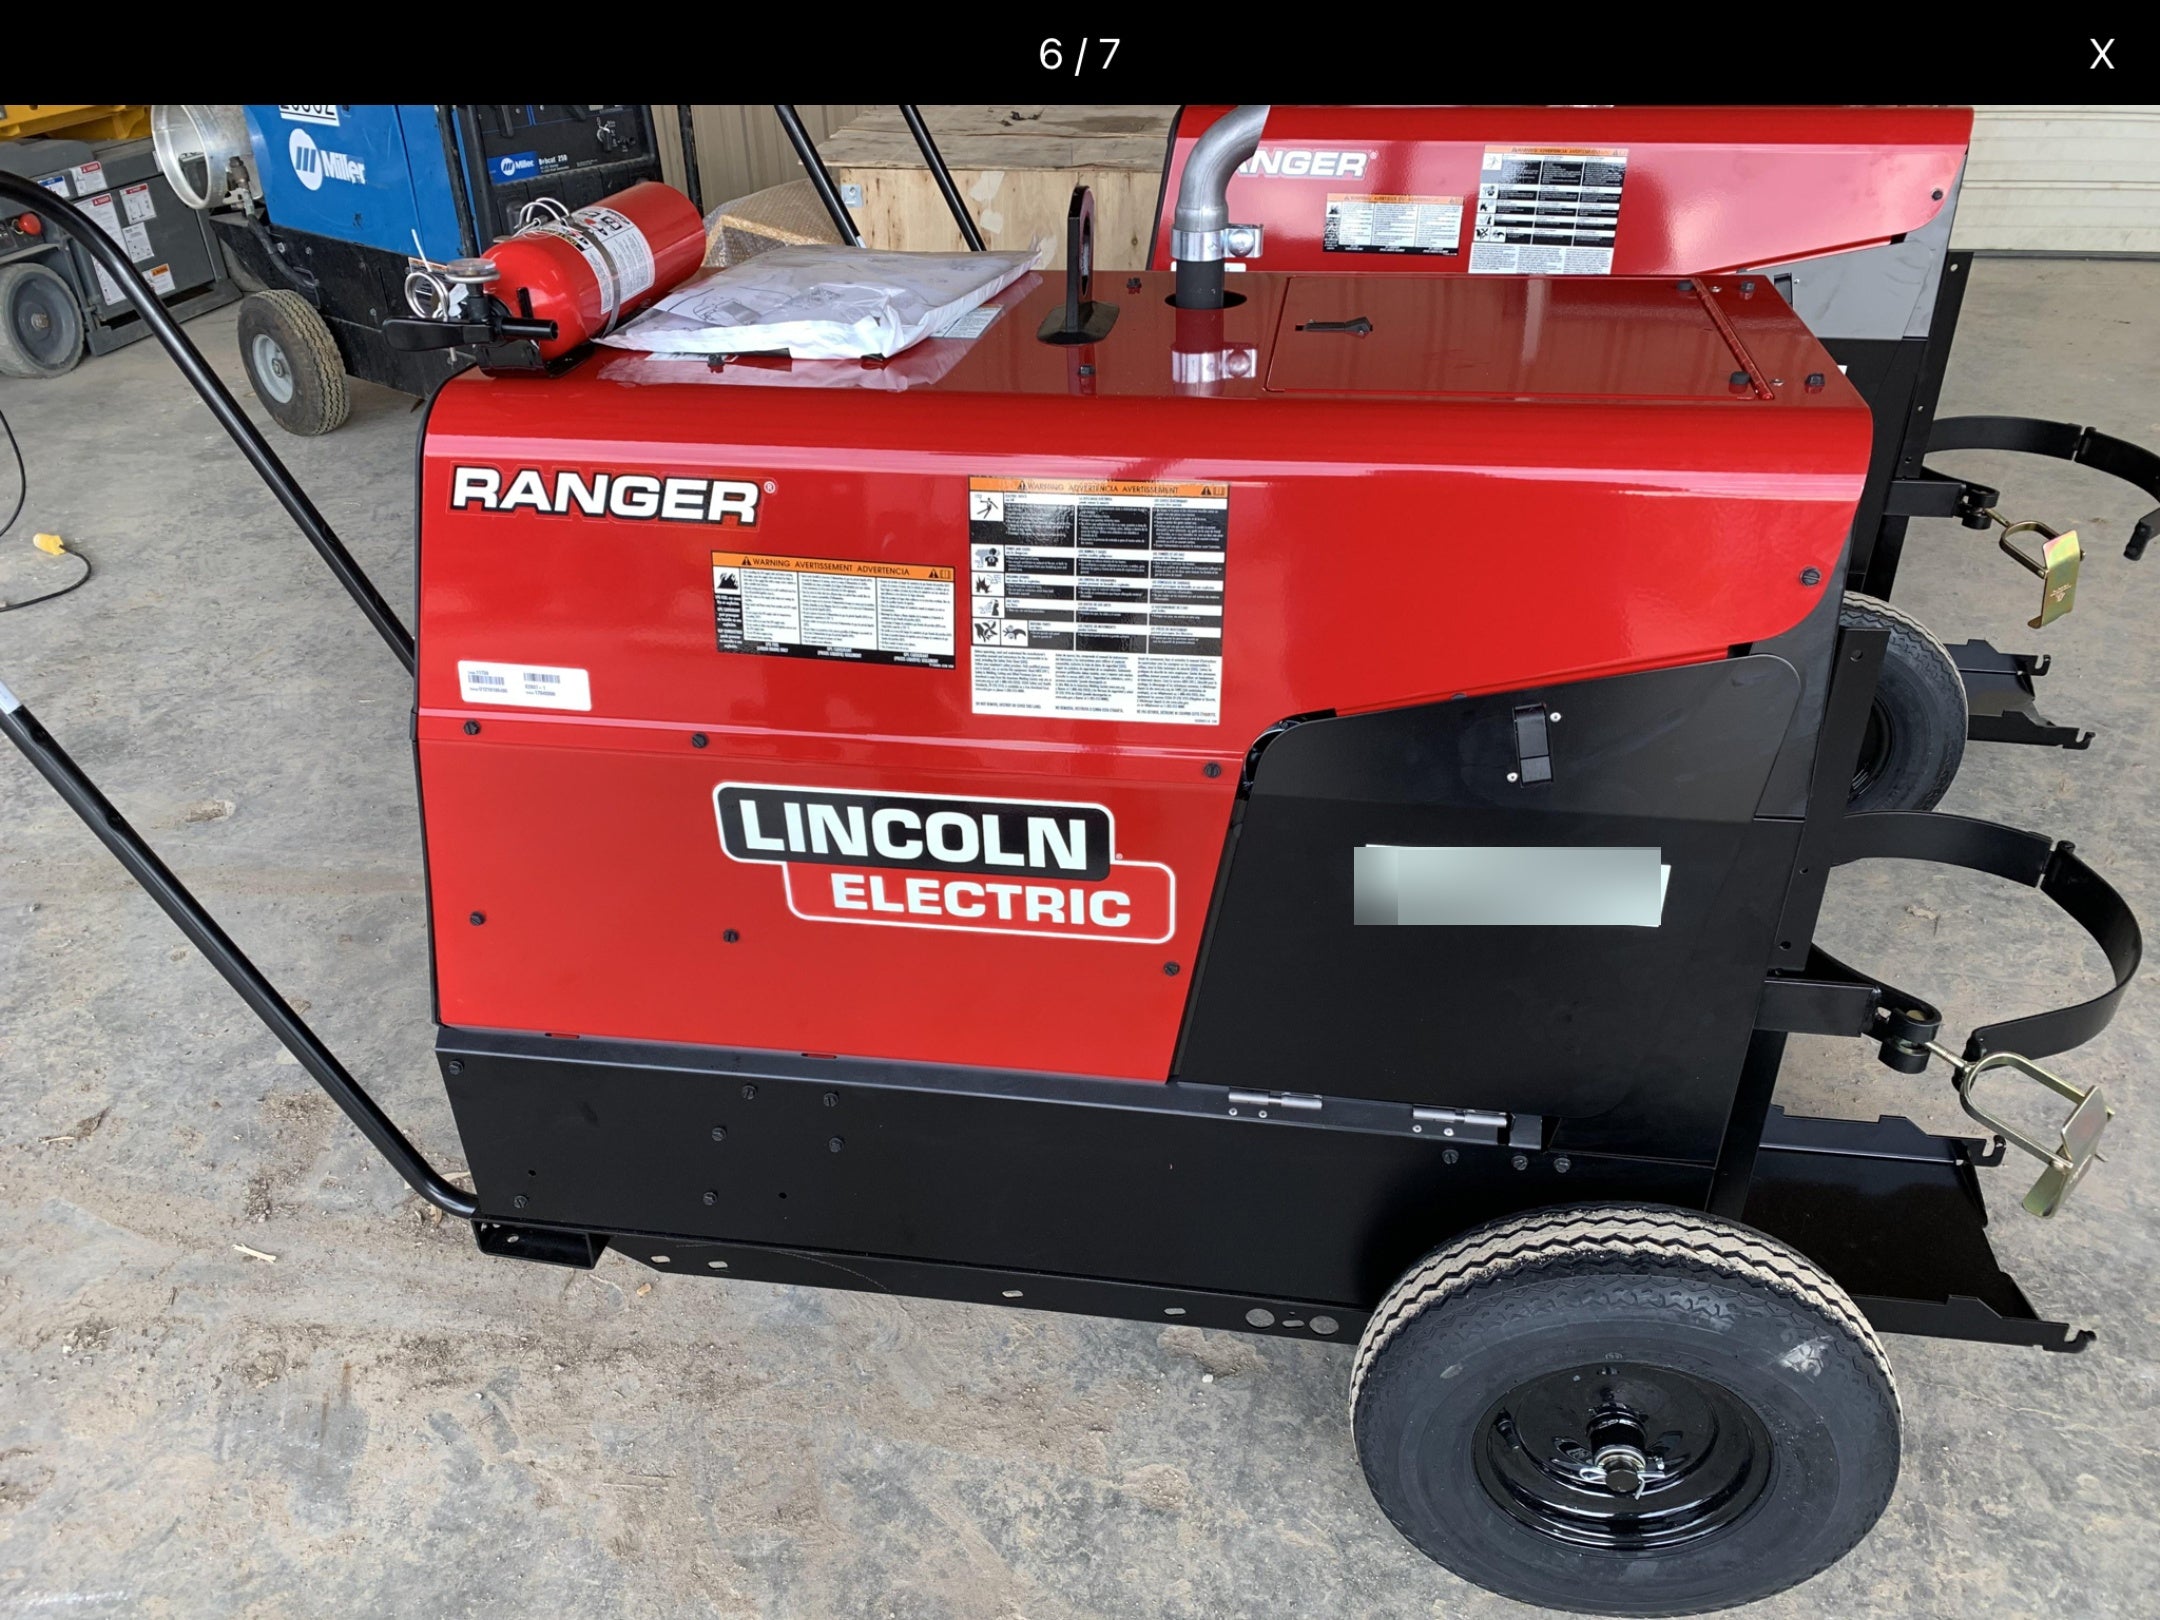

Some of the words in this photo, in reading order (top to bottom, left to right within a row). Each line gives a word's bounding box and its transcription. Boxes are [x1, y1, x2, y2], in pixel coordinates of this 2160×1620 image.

[320, 149, 366, 185] Miller
[1026, 481, 1064, 491] WARNING
[1069, 483, 1119, 493] ADVERTENCIA
[1122, 484, 1179, 495] AVERTISSEMENT
[752, 557, 791, 568] WARNING
[794, 560, 853, 571] AVERTISSEMENT
[856, 565, 910, 576] ADVERTENCIA
[738, 798, 1088, 871] LINCOLN
[830, 872, 1132, 927] ELECTRIC
